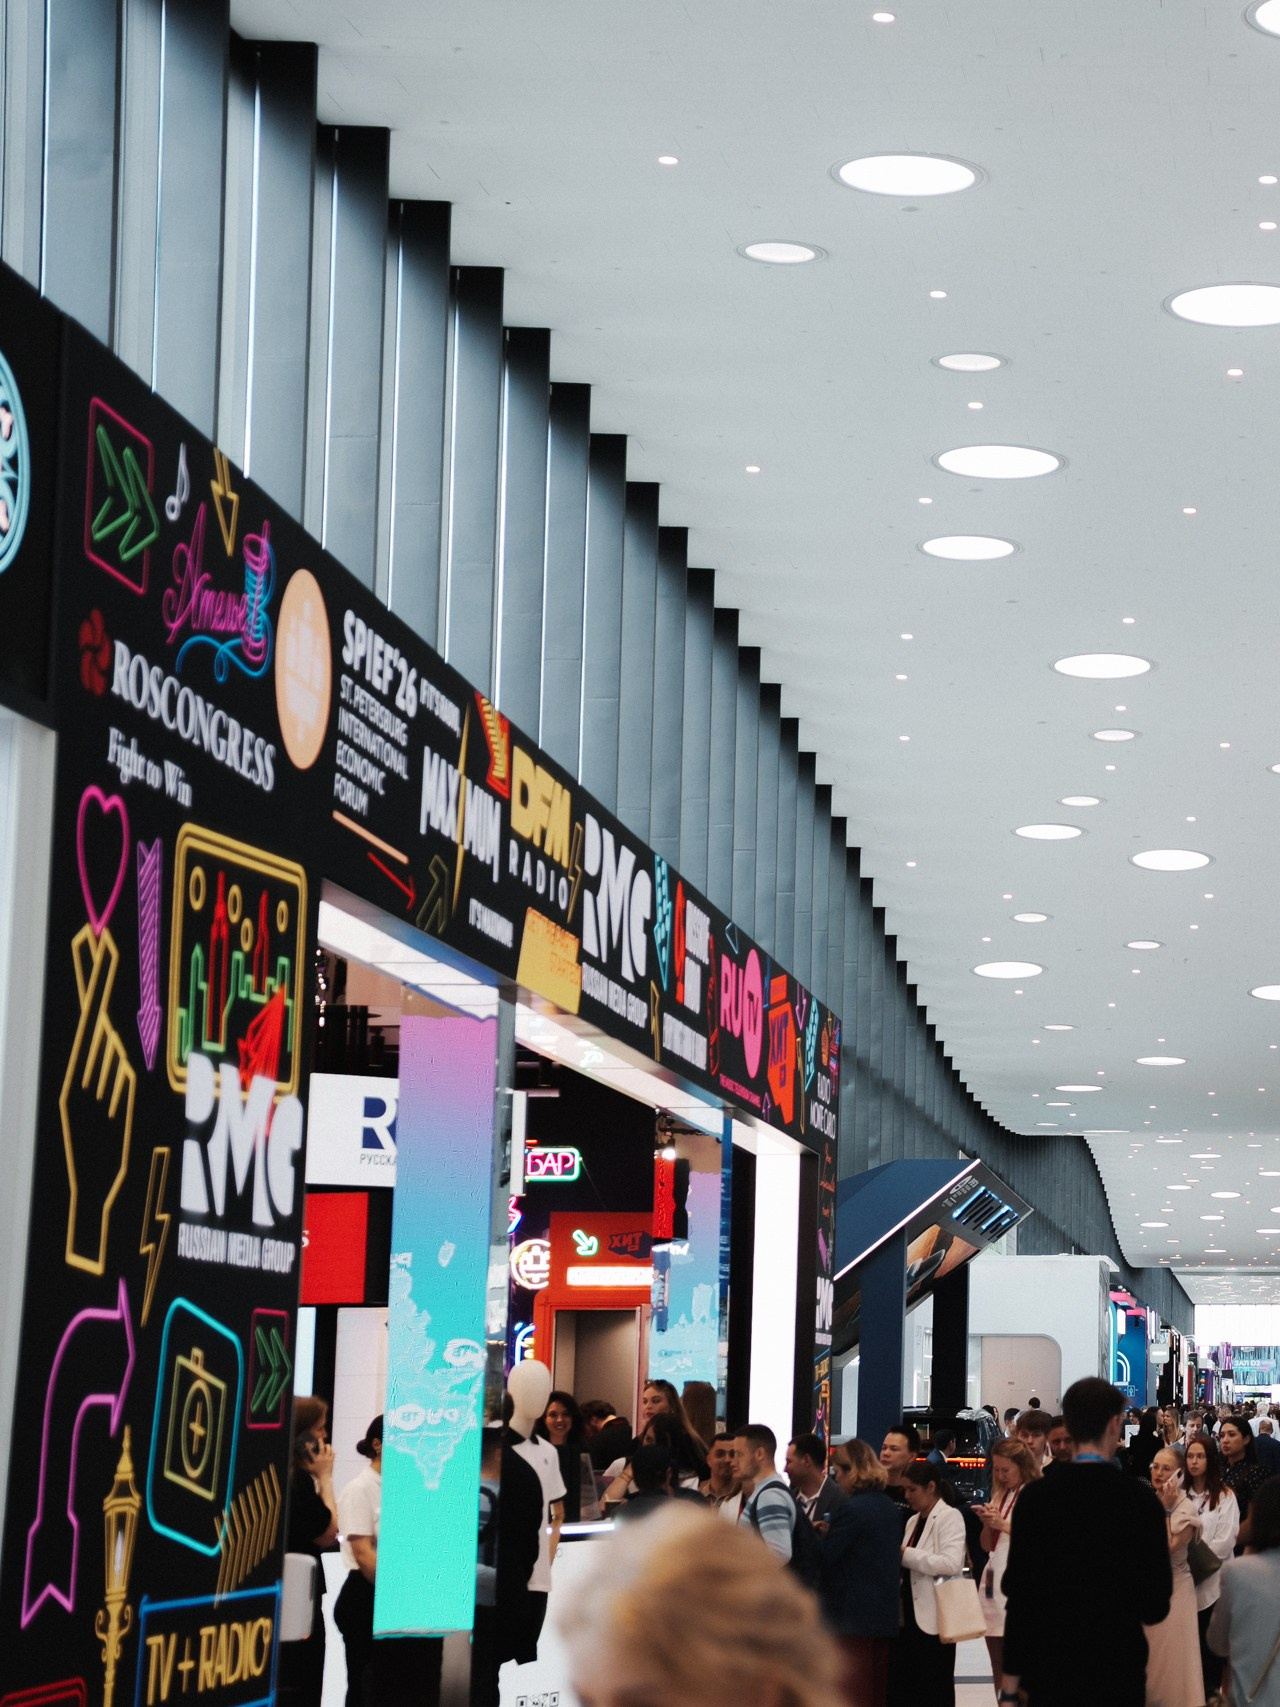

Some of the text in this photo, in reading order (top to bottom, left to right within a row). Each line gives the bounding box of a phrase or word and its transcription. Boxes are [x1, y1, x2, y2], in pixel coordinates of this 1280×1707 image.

[111, 639, 276, 792] ROSCONGRESS
[338, 706, 409, 781] INTERNATIONAL
[353, 678, 408, 746] PETERSBURG
[107, 726, 193, 808] Fight to Win
[334, 772, 369, 817] FORUM
[336, 739, 386, 796] ECONOMIC
[511, 745, 571, 869] DFM
[509, 838, 569, 911] RADIO
[720, 953, 744, 1039] RU
[180, 1051, 303, 1226] RMG
[527, 1152, 574, 1176] БАР
[178, 1222, 227, 1263] RUSSIAN
[227, 1231, 260, 1269] MEDIA
[261, 1239, 295, 1274] GROUP
[146, 1632, 178, 1706] TV
[198, 1617, 273, 1692] RADIO
